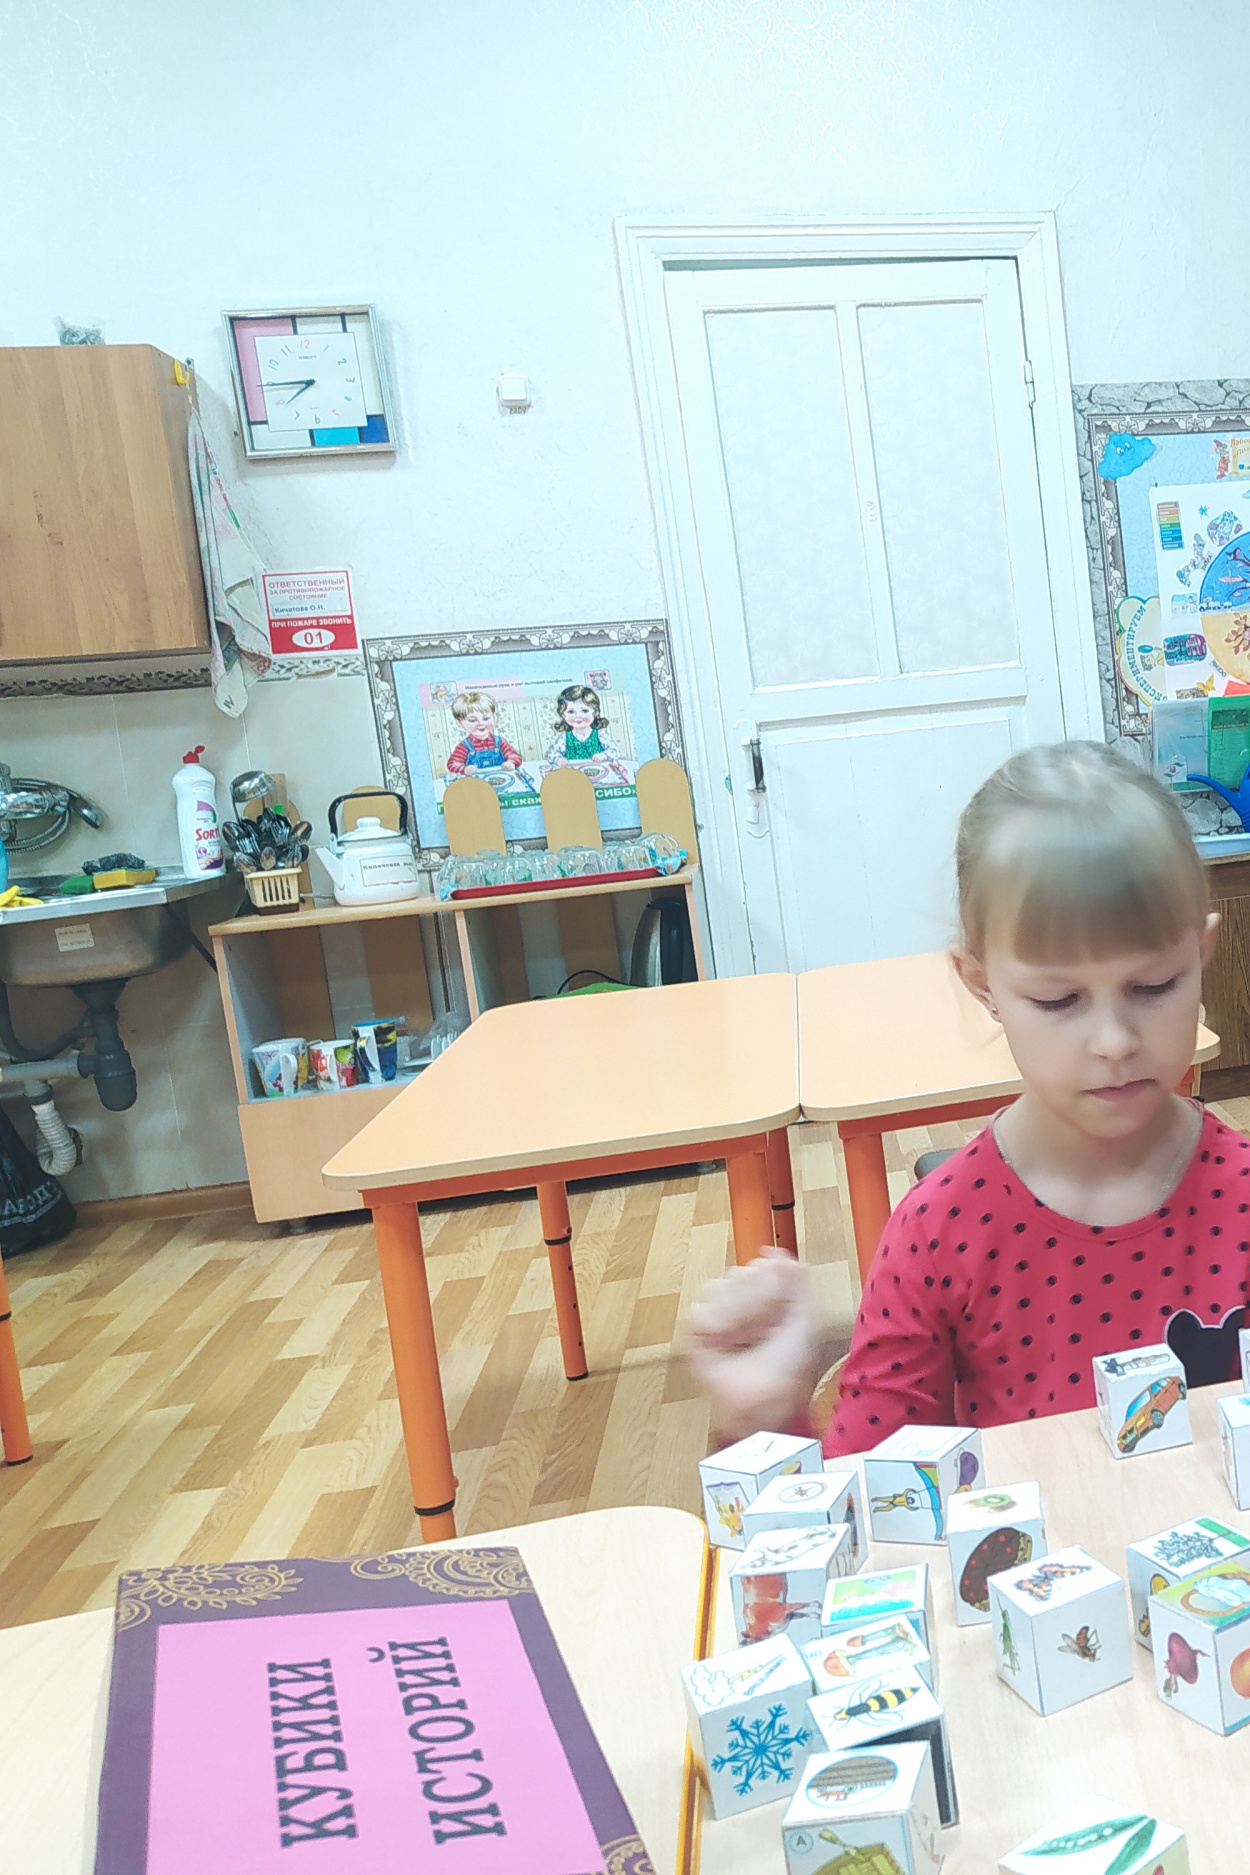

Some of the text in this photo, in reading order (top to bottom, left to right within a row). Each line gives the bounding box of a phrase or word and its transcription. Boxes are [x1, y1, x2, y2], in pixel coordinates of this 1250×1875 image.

[300, 339, 310, 350] 12
[281, 345, 292, 356] 11
[269, 359, 279, 370] 10
[268, 578, 345, 589] ОТВЕТСТВЕННЫЙ
[279, 586, 345, 595] ПРОТИВОПОЖАРНОЕ
[271, 617, 353, 629] ПРИ ПОЖАРЕ ЗВОНИТЬ
[303, 631, 323, 645] 01
[366, 1636, 507, 1845] ИСТОРИЙ
[266, 1658, 359, 1848] КУБИКИ
